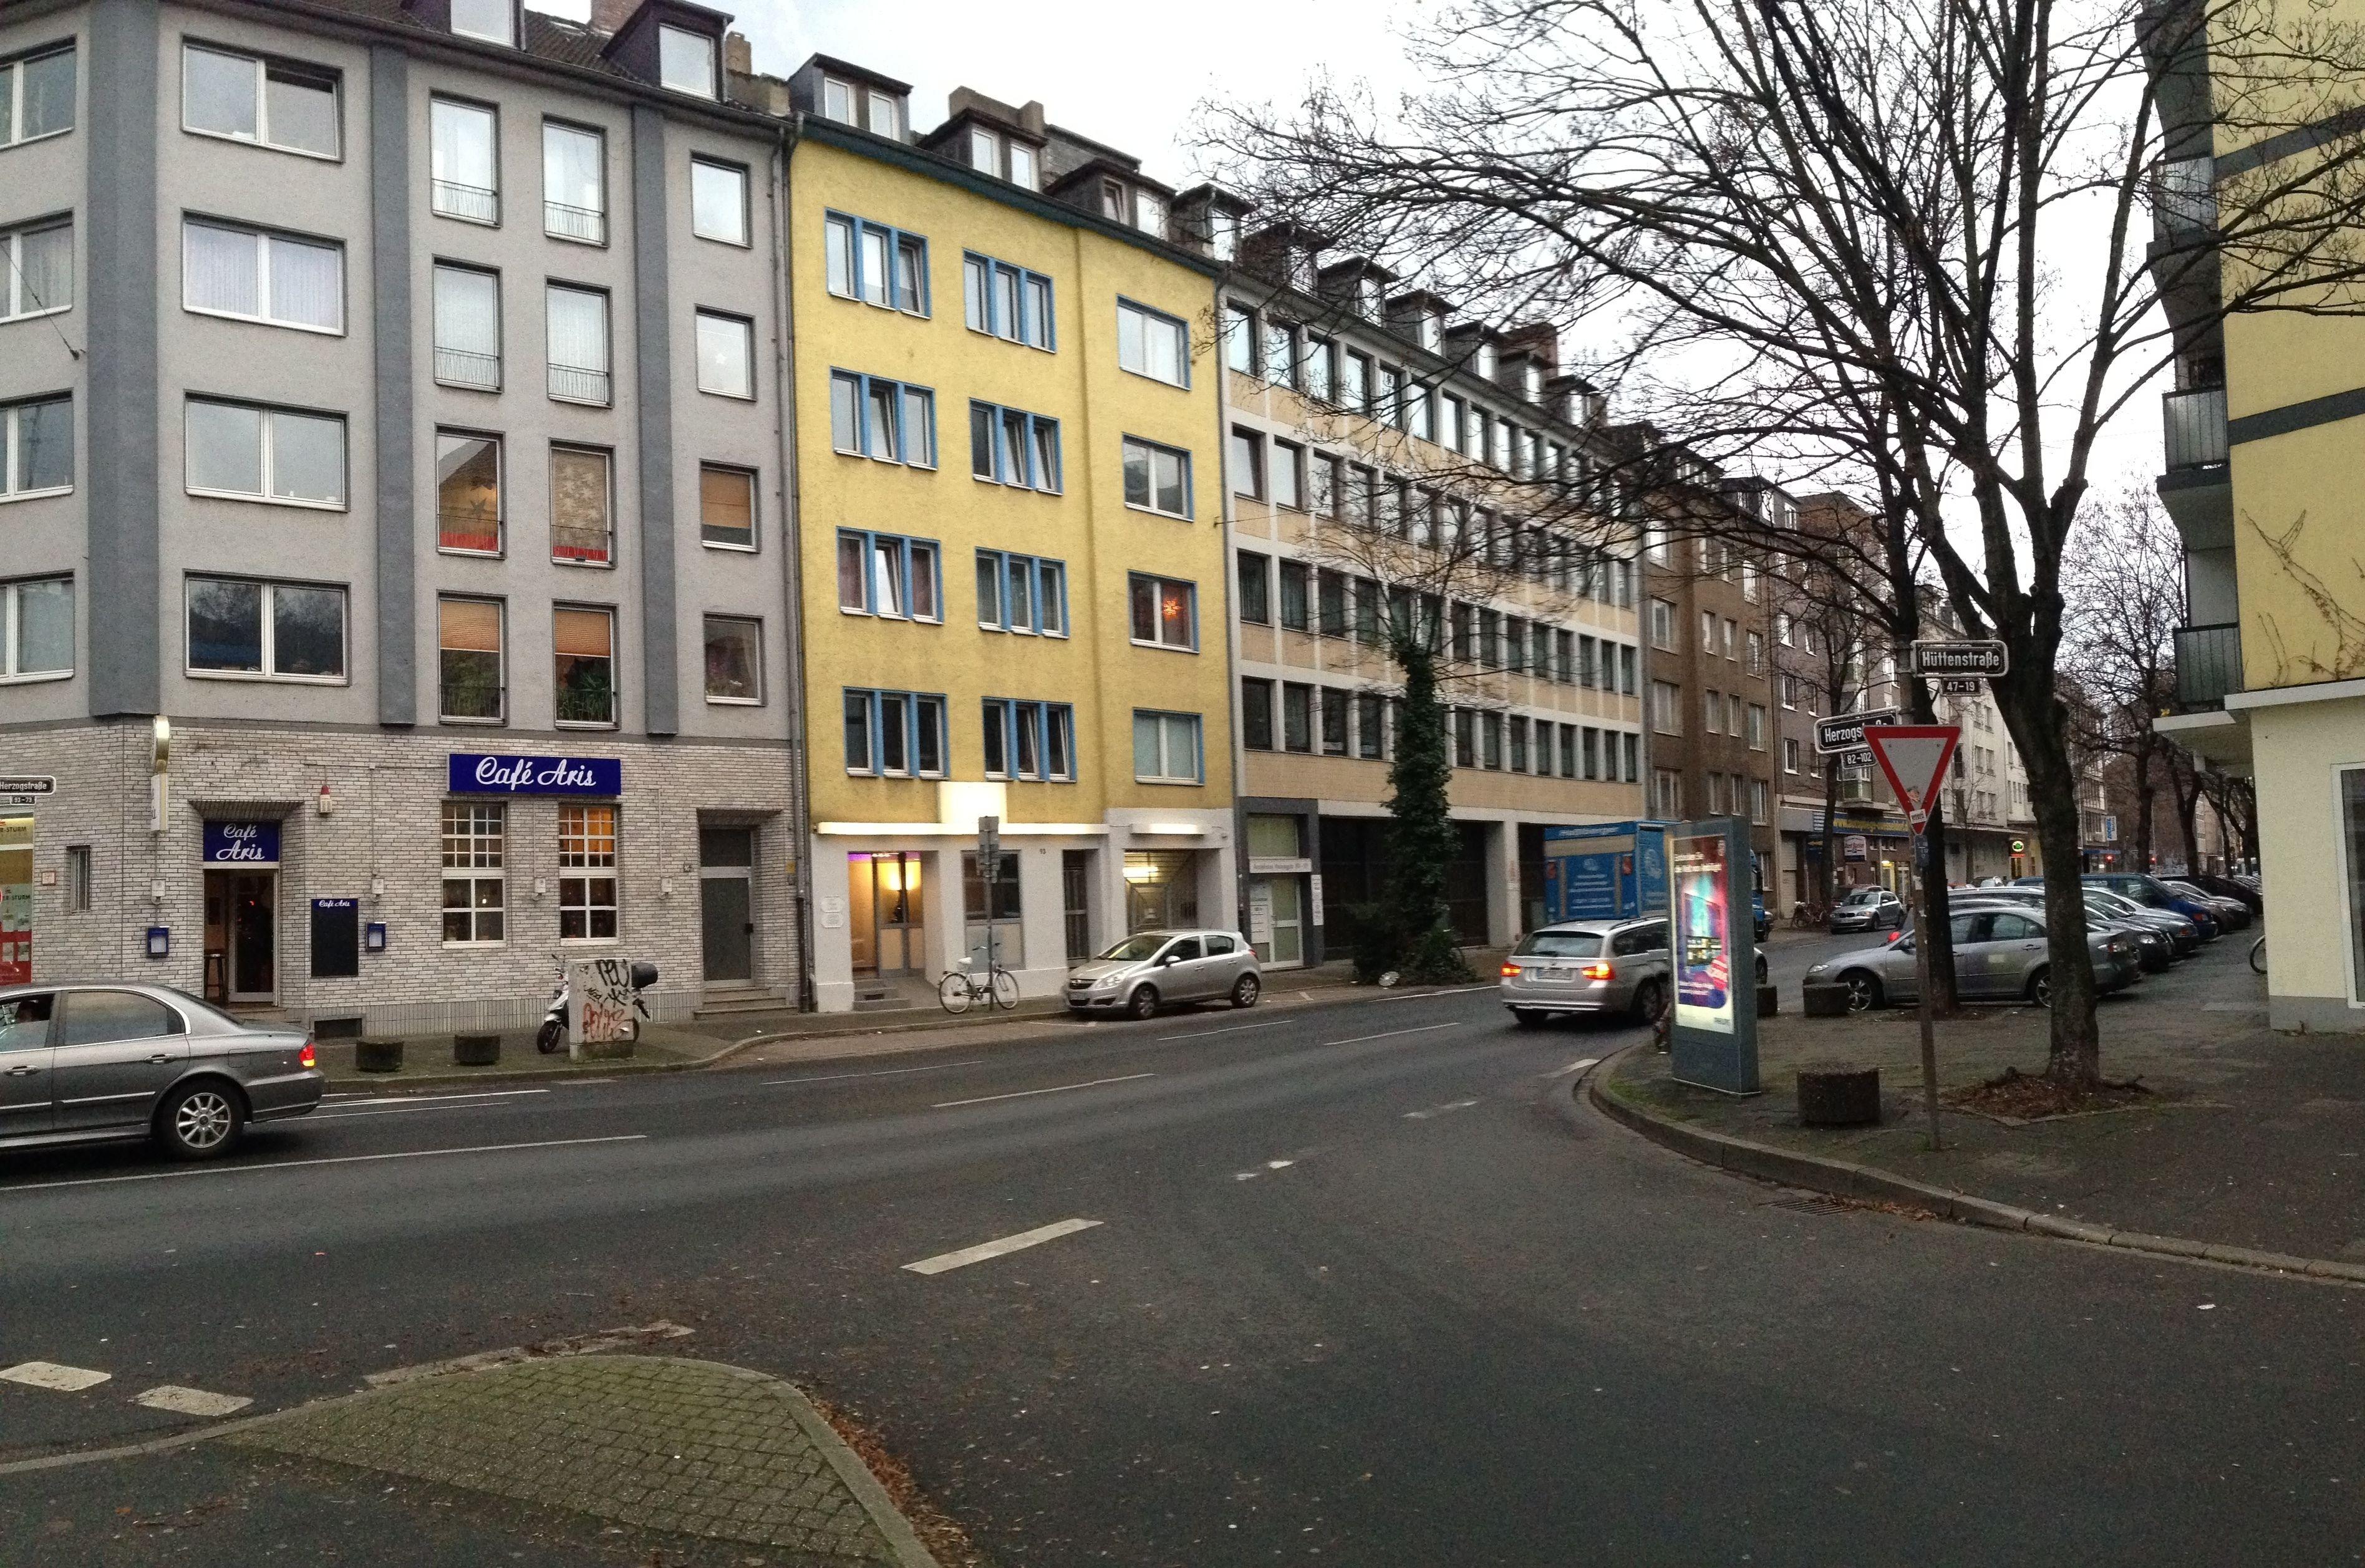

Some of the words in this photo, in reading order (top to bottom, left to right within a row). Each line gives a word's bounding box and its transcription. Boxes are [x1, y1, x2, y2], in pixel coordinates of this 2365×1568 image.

[1922, 651, 2000, 669] Hüttenstraße
[1947, 681, 1975, 692] 47-19
[1847, 752, 1872, 765] 82-102
[476, 757, 534, 790] Café
[537, 758, 596, 786] Aris
[0, 781, 47, 791] Herzogstraße
[223, 823, 258, 841] Café
[216, 840, 264, 859] Aris
[319, 899, 334, 908] Café
